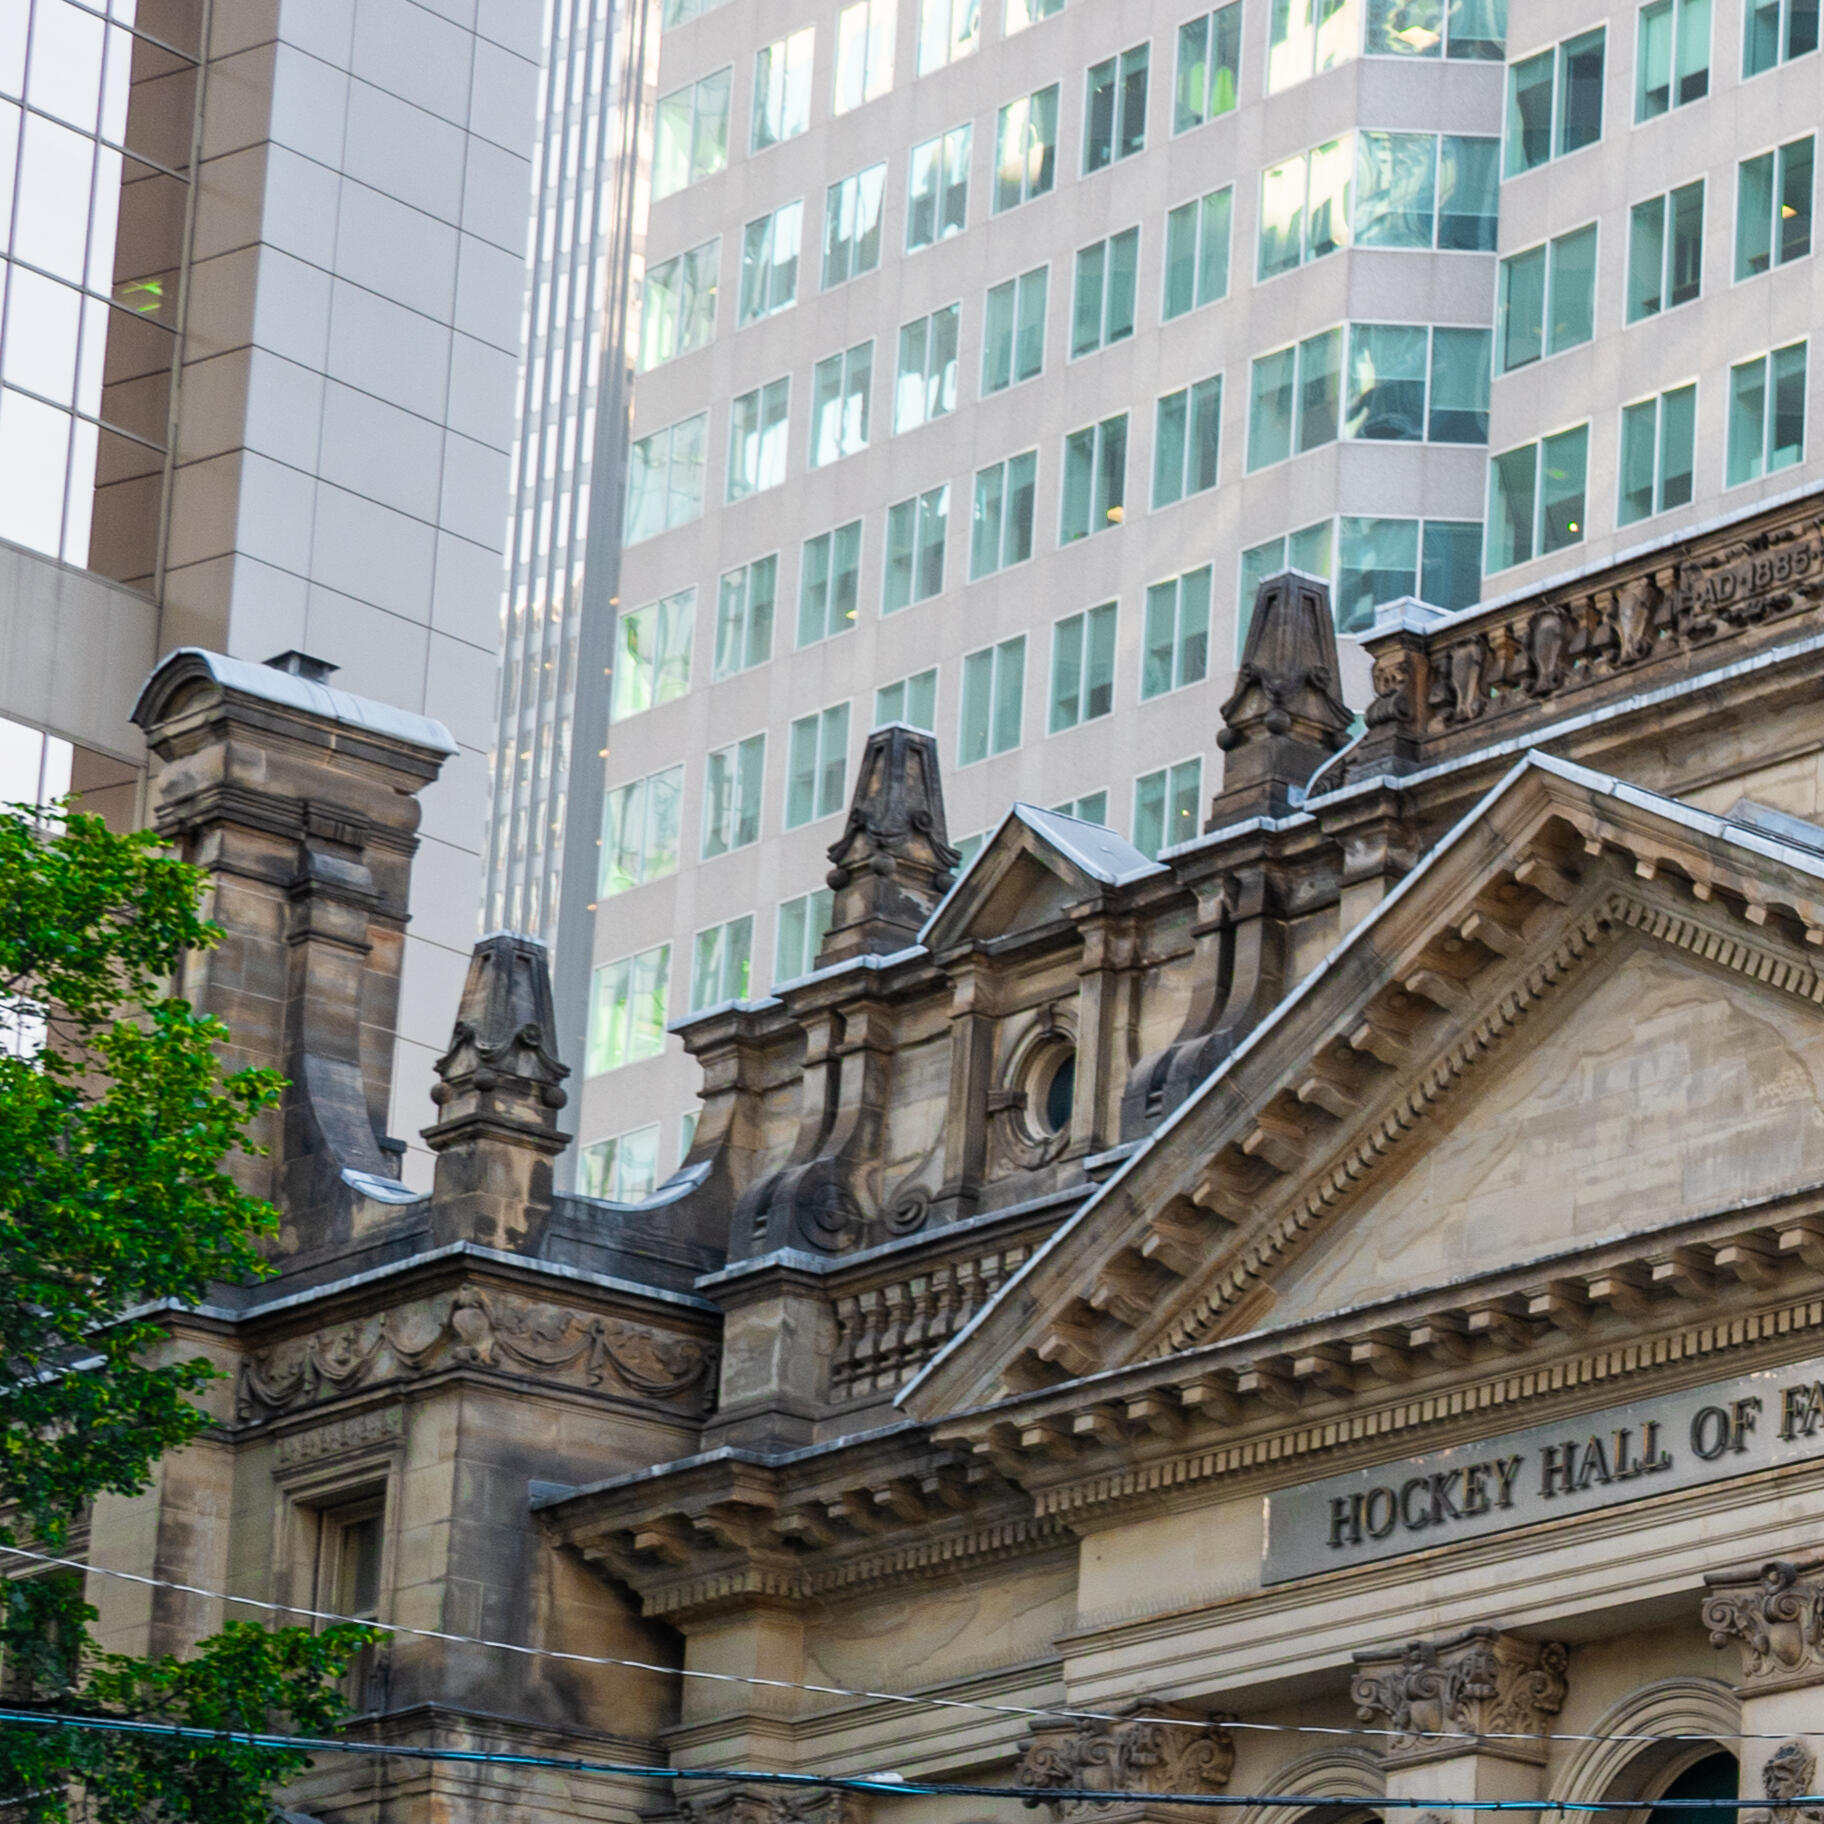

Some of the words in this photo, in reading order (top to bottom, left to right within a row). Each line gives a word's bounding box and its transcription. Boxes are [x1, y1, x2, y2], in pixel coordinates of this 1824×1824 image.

[1326, 1453, 1525, 1548] HOCKEY
[1538, 1420, 1672, 1500] HALL
[1690, 1396, 1763, 1460] OF
